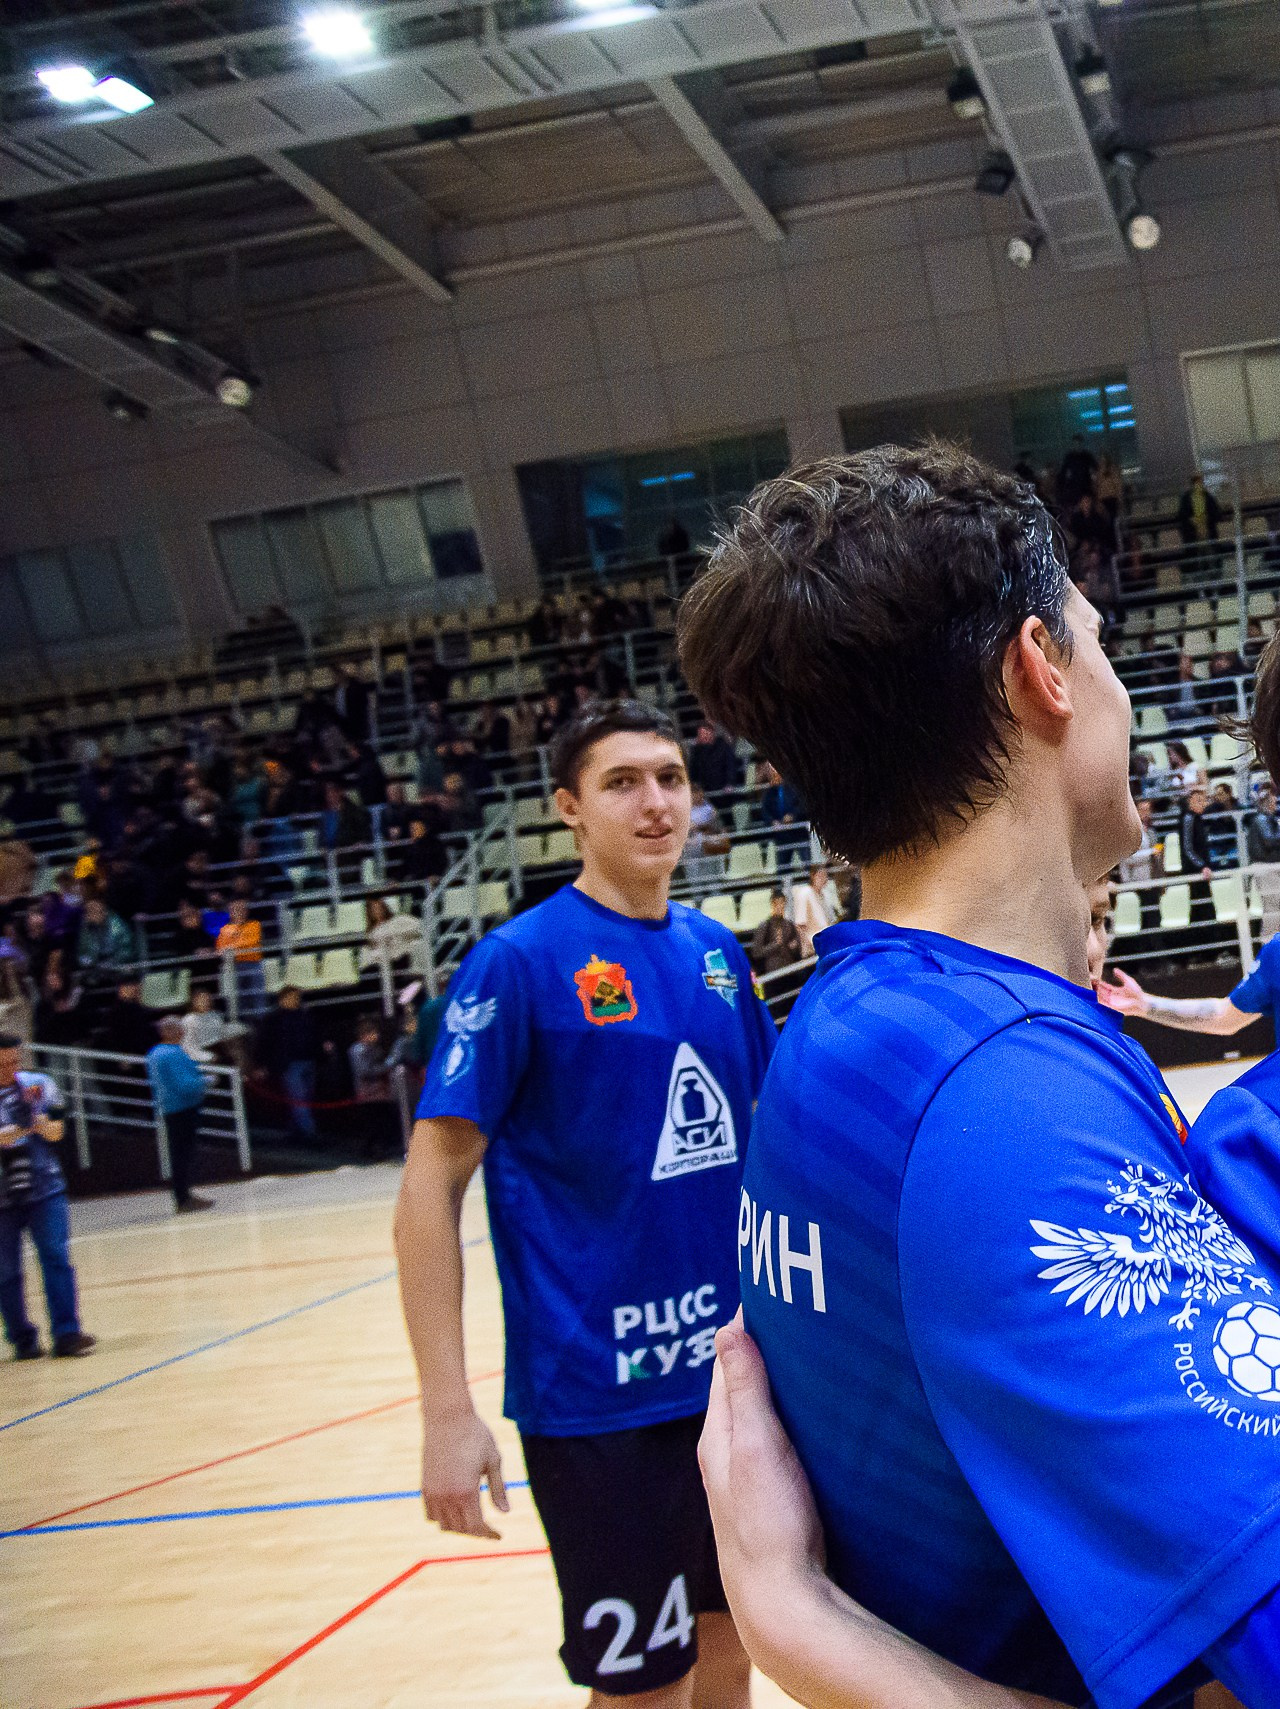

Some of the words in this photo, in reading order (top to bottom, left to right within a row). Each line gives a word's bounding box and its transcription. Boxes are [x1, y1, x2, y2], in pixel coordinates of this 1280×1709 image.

[738, 1185, 827, 1313] РИН
[613, 1283, 718, 1340] РЦСС
[583, 1573, 695, 1676] 24
